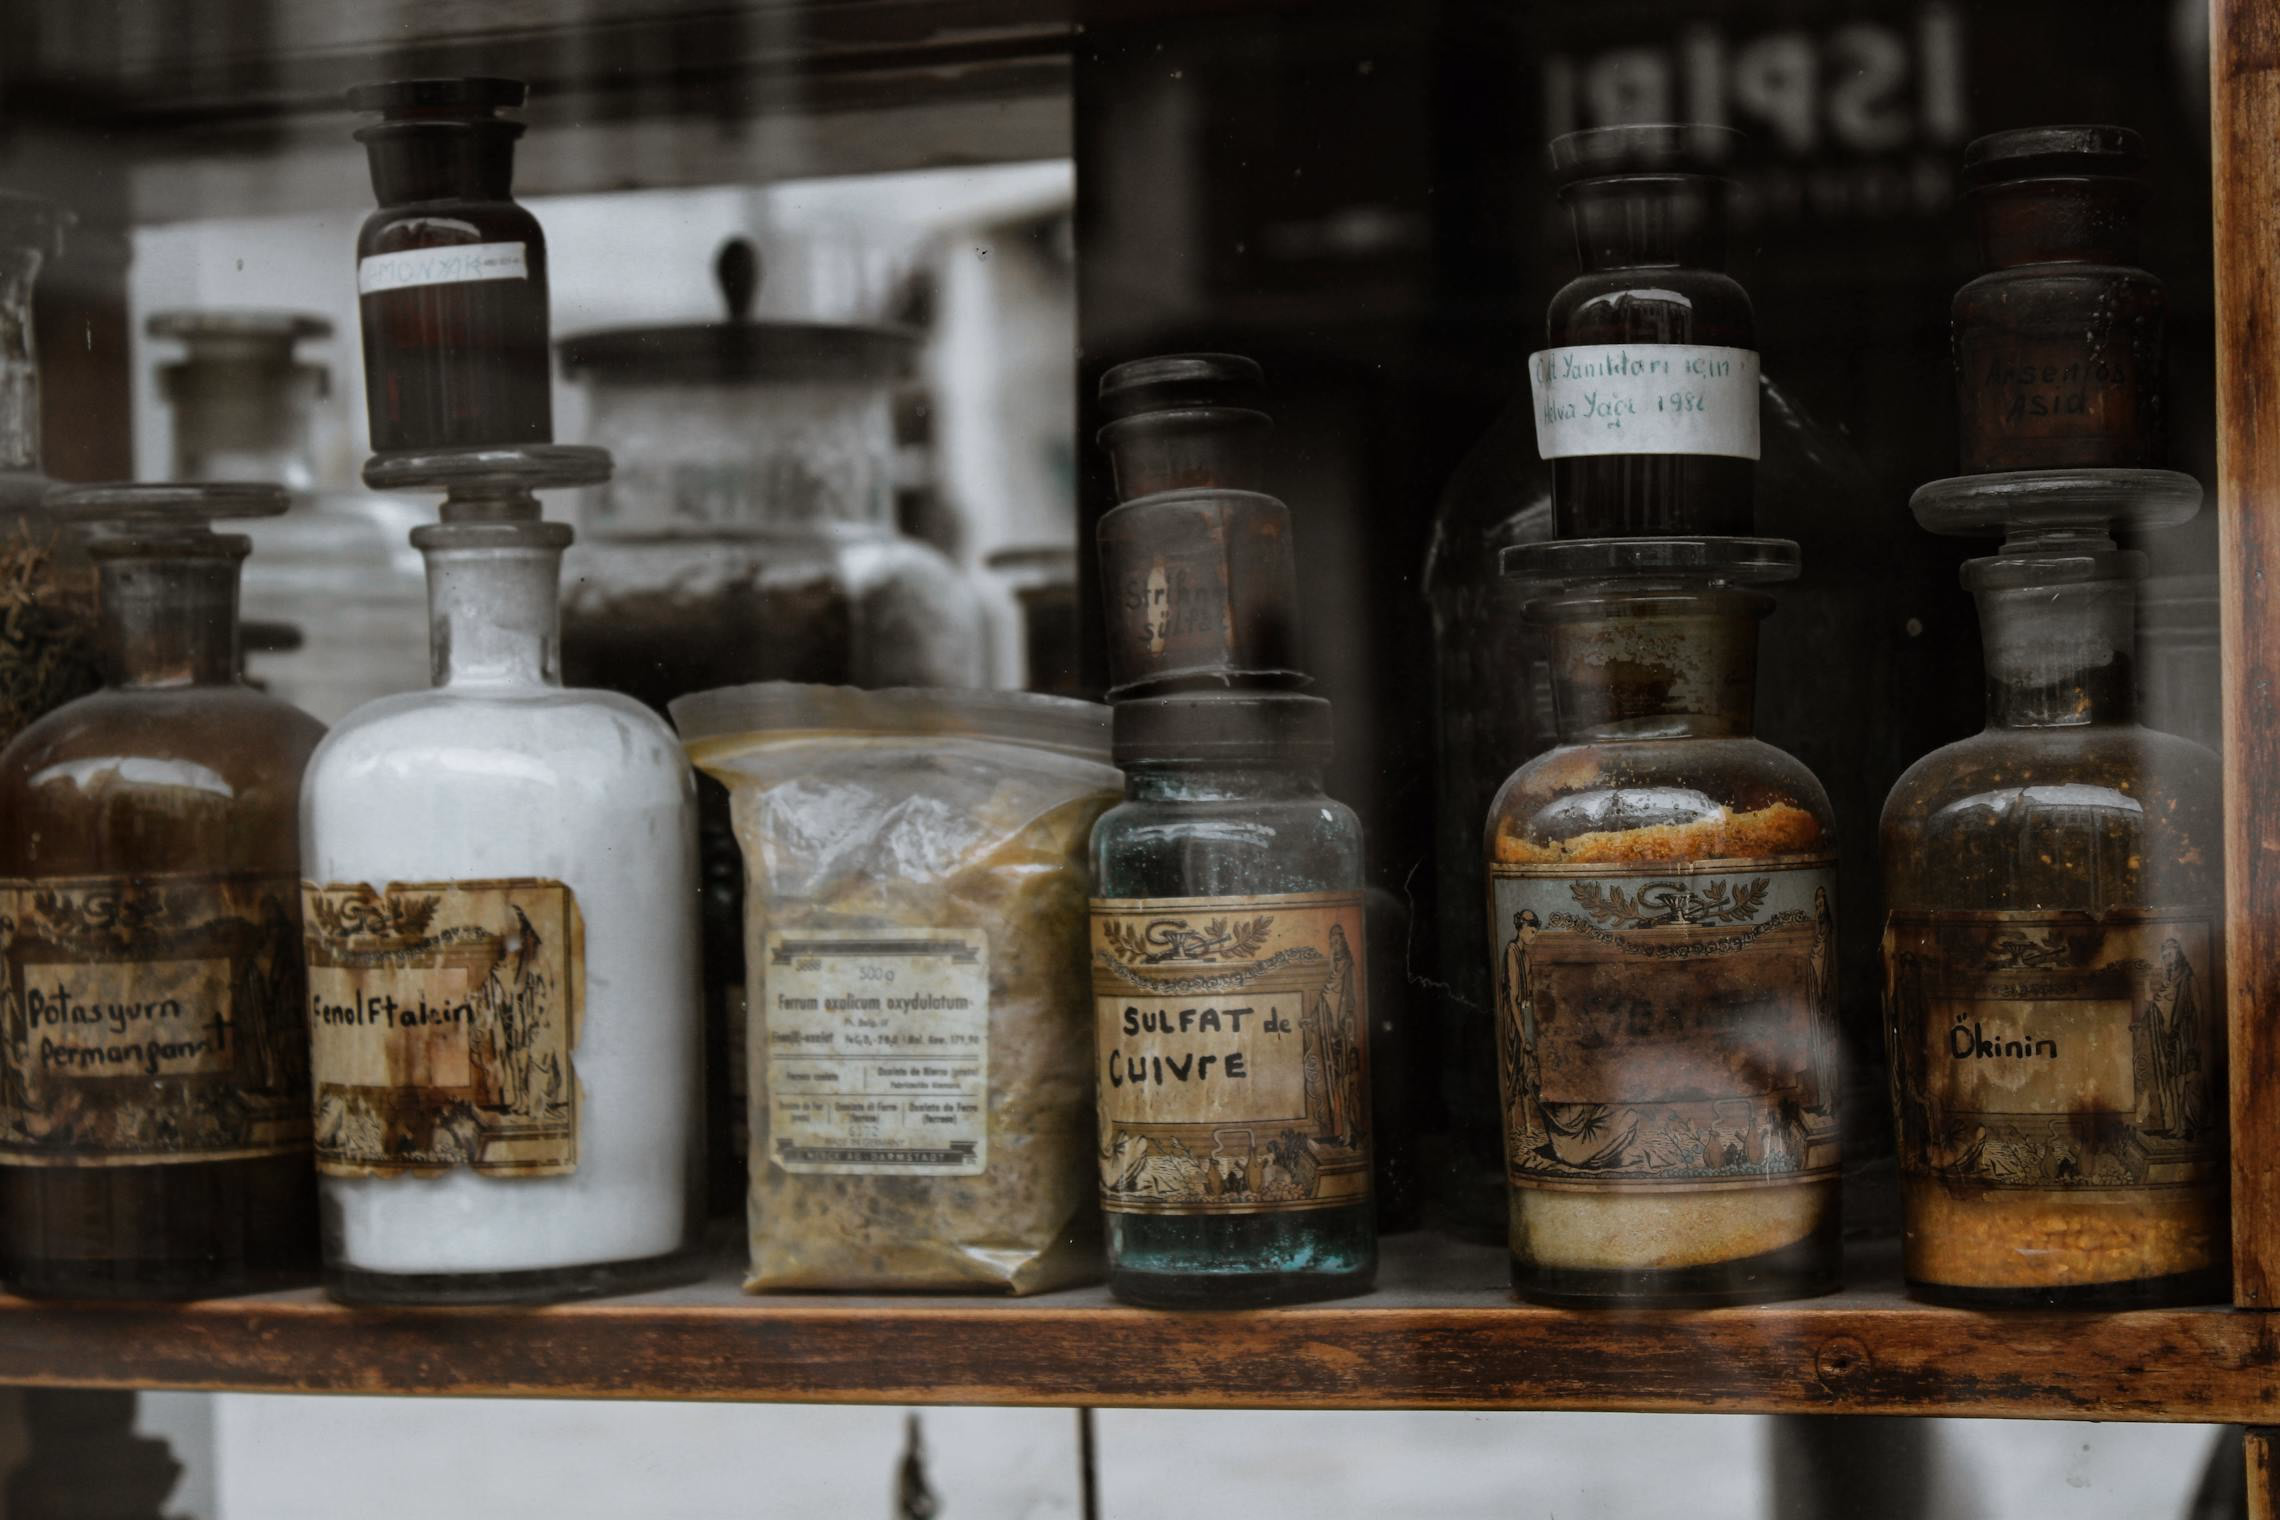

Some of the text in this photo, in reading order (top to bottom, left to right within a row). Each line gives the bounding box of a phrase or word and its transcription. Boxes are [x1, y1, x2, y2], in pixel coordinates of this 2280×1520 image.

[1123, 1006, 1293, 1037] SULFAT de
[1949, 1011, 2058, 1060] Ökinin
